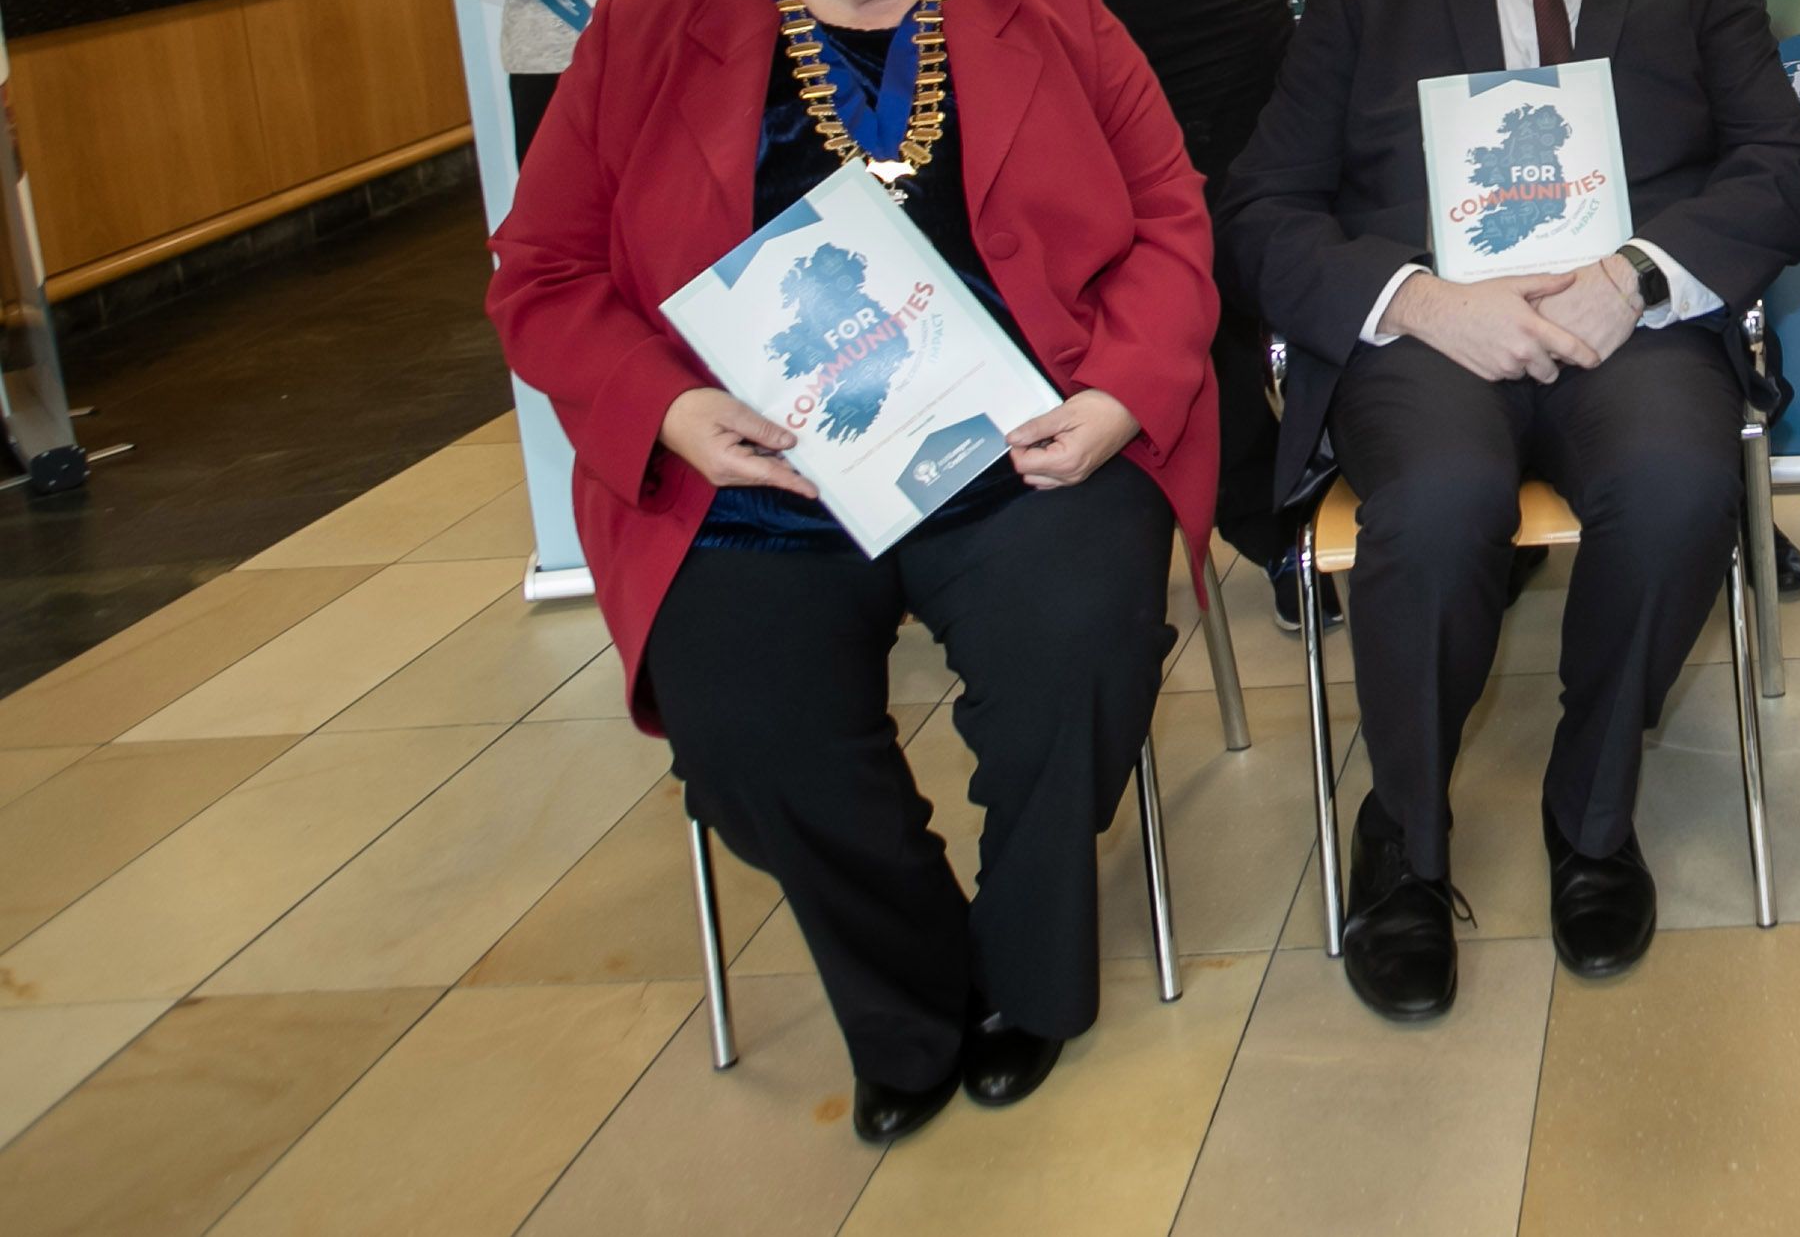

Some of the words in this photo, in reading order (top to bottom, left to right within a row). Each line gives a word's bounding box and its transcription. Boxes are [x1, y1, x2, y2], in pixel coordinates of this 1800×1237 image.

[1450, 169, 1607, 224] COMMUNITIES
[1510, 165, 1556, 183] FOR
[823, 306, 880, 351] FOR
[786, 281, 935, 430] COMMUNITIES
